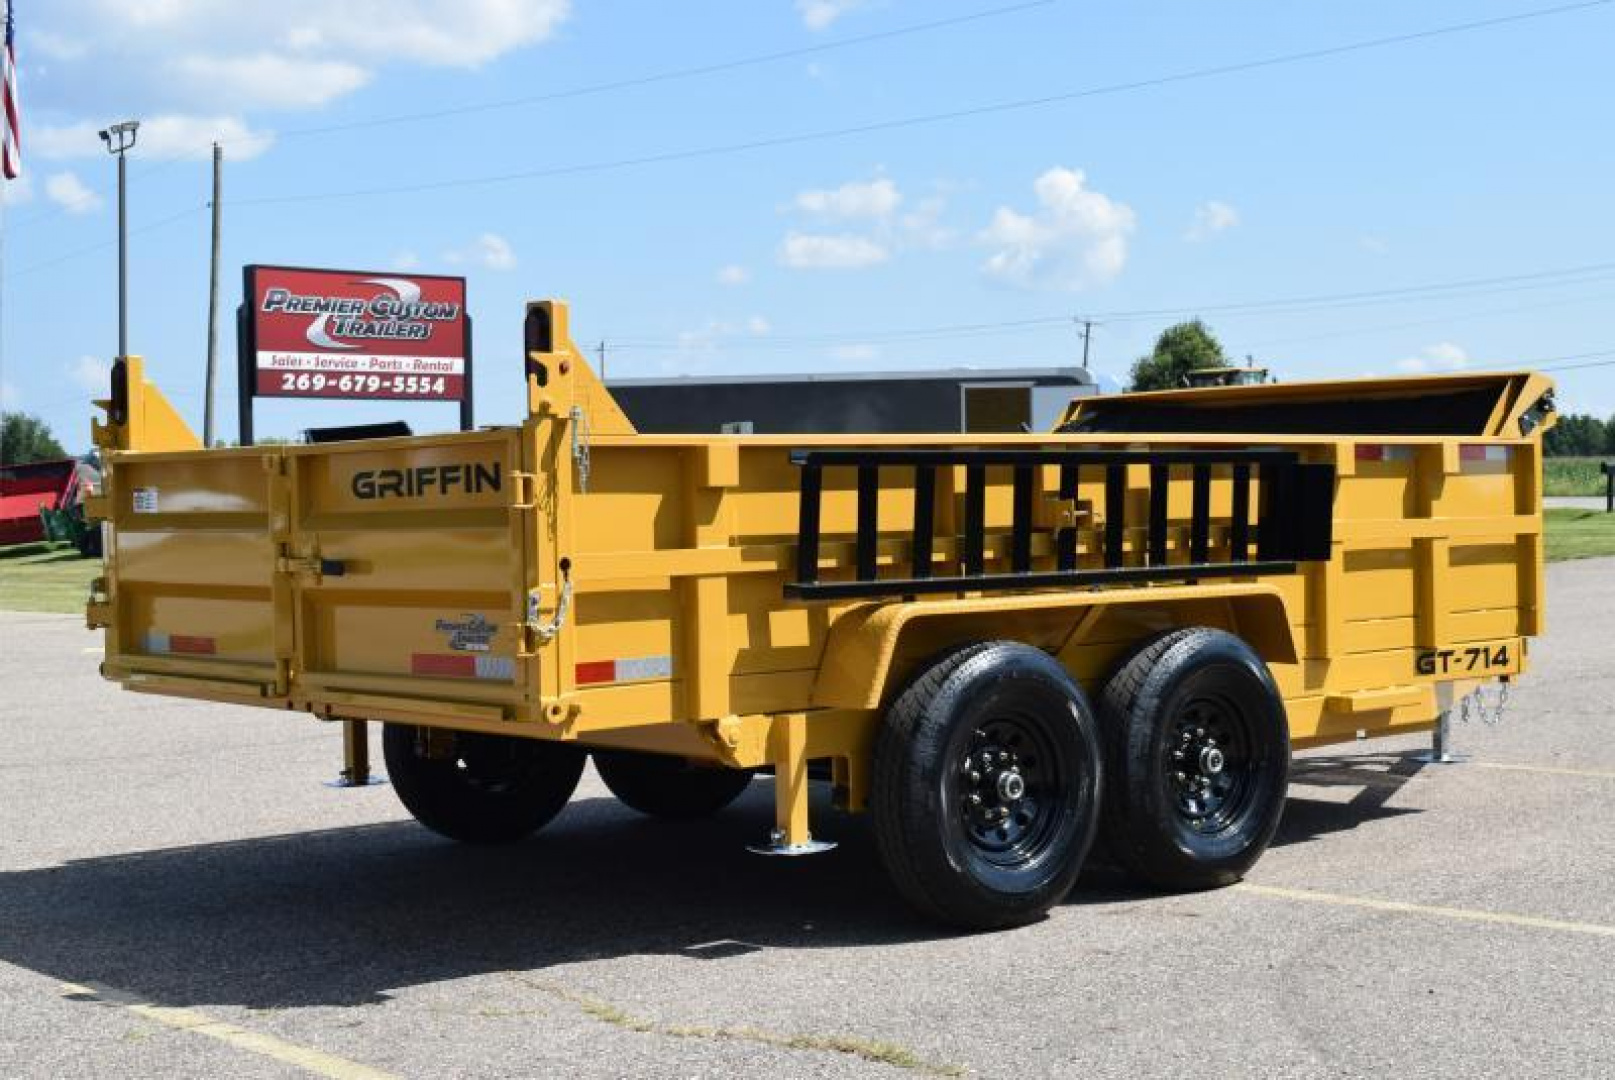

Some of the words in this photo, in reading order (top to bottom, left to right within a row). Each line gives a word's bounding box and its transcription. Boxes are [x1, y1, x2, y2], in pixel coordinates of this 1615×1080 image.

[262, 288, 364, 314] PREMIER
[369, 294, 459, 321] CUSTOM
[271, 354, 302, 367] Sales
[313, 355, 359, 369] Service
[369, 357, 403, 370] Parts
[413, 358, 454, 372] Rental
[281, 372, 445, 394] 269-679-5554
[352, 462, 501, 499] GRIFFIN
[1416, 646, 1509, 674] GT-714
